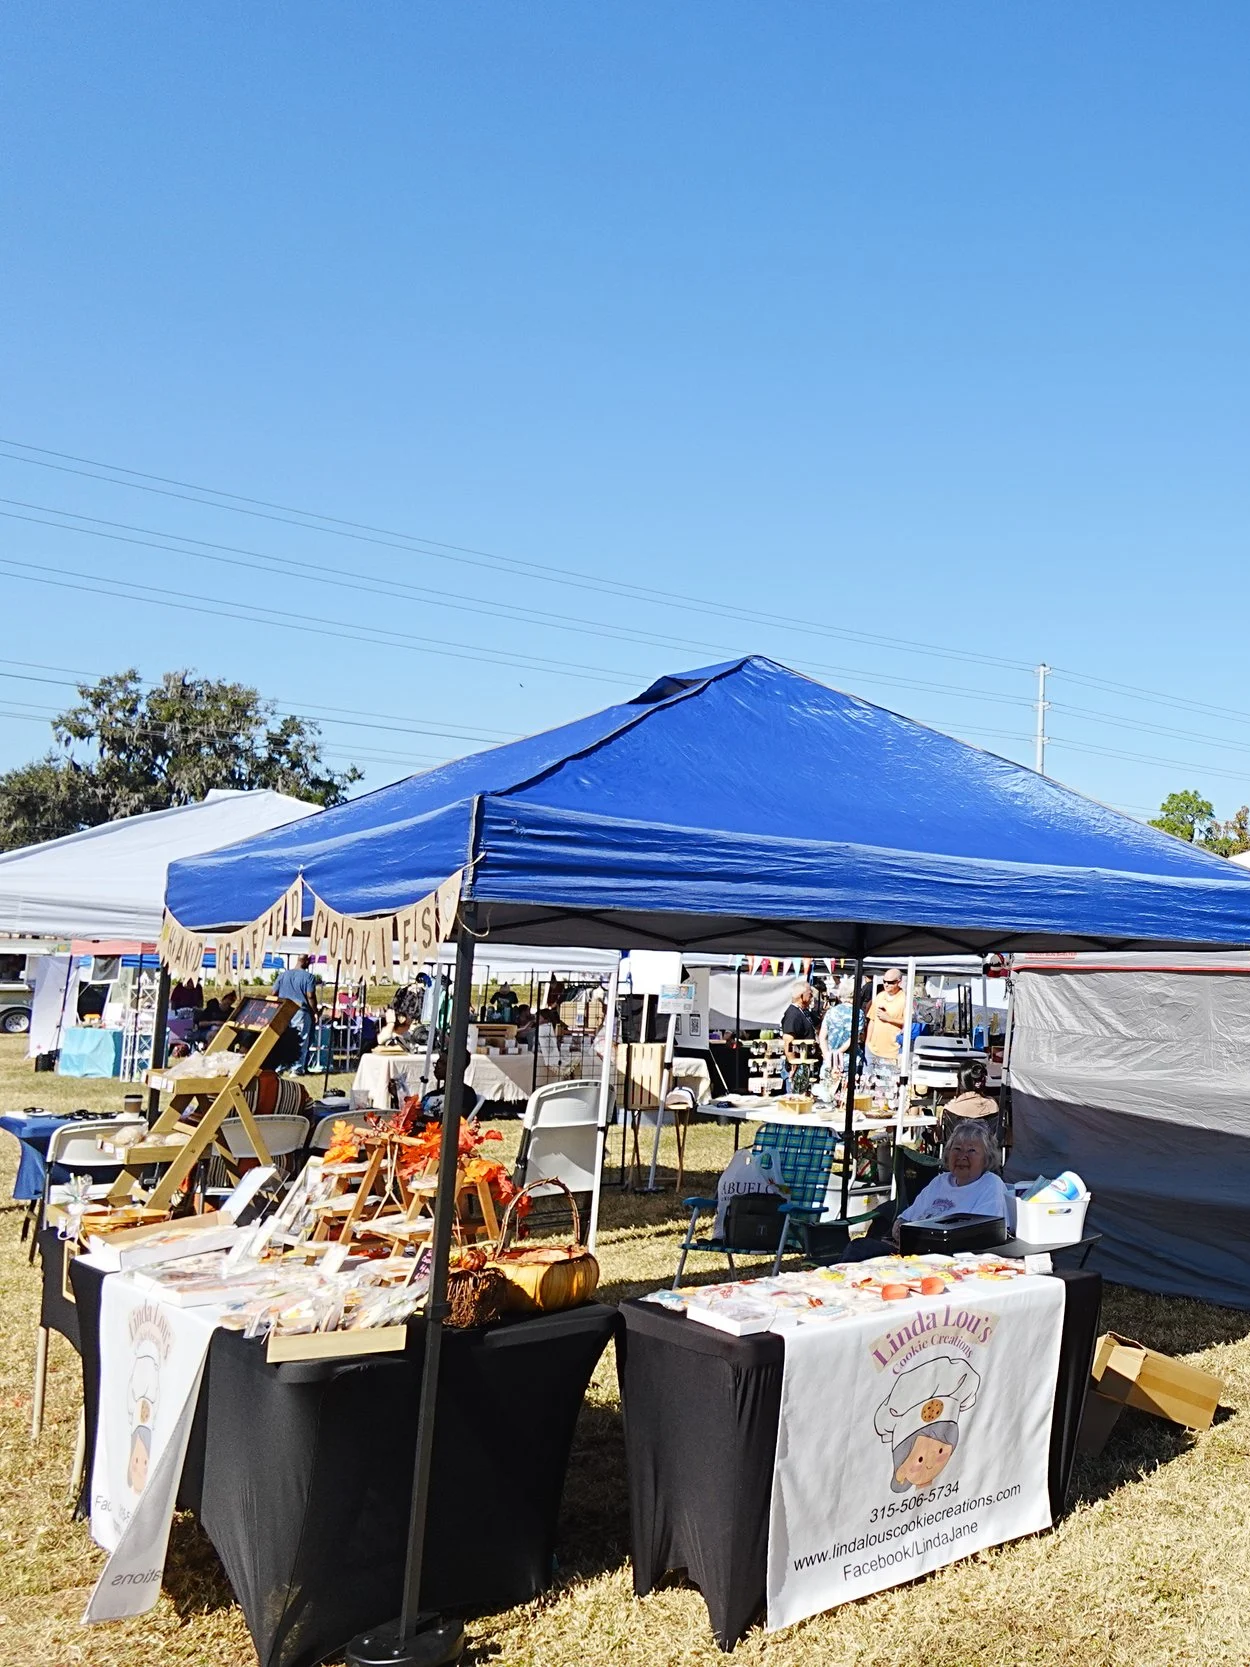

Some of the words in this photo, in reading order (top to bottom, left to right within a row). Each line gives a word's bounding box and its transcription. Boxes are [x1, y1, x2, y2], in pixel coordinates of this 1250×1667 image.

[314, 907, 432, 969] COOKIES
[872, 1310, 937, 1369] Linda
[943, 1305, 993, 1343] Lou's
[892, 1339, 928, 1375] Cookie
[931, 1334, 973, 1359] Creations
[793, 1483, 1022, 1571] www.lindalouscookiecreations.com
[869, 1480, 960, 1523] 315-506-5734
[843, 1521, 979, 1581] Facebook/LindaJane
